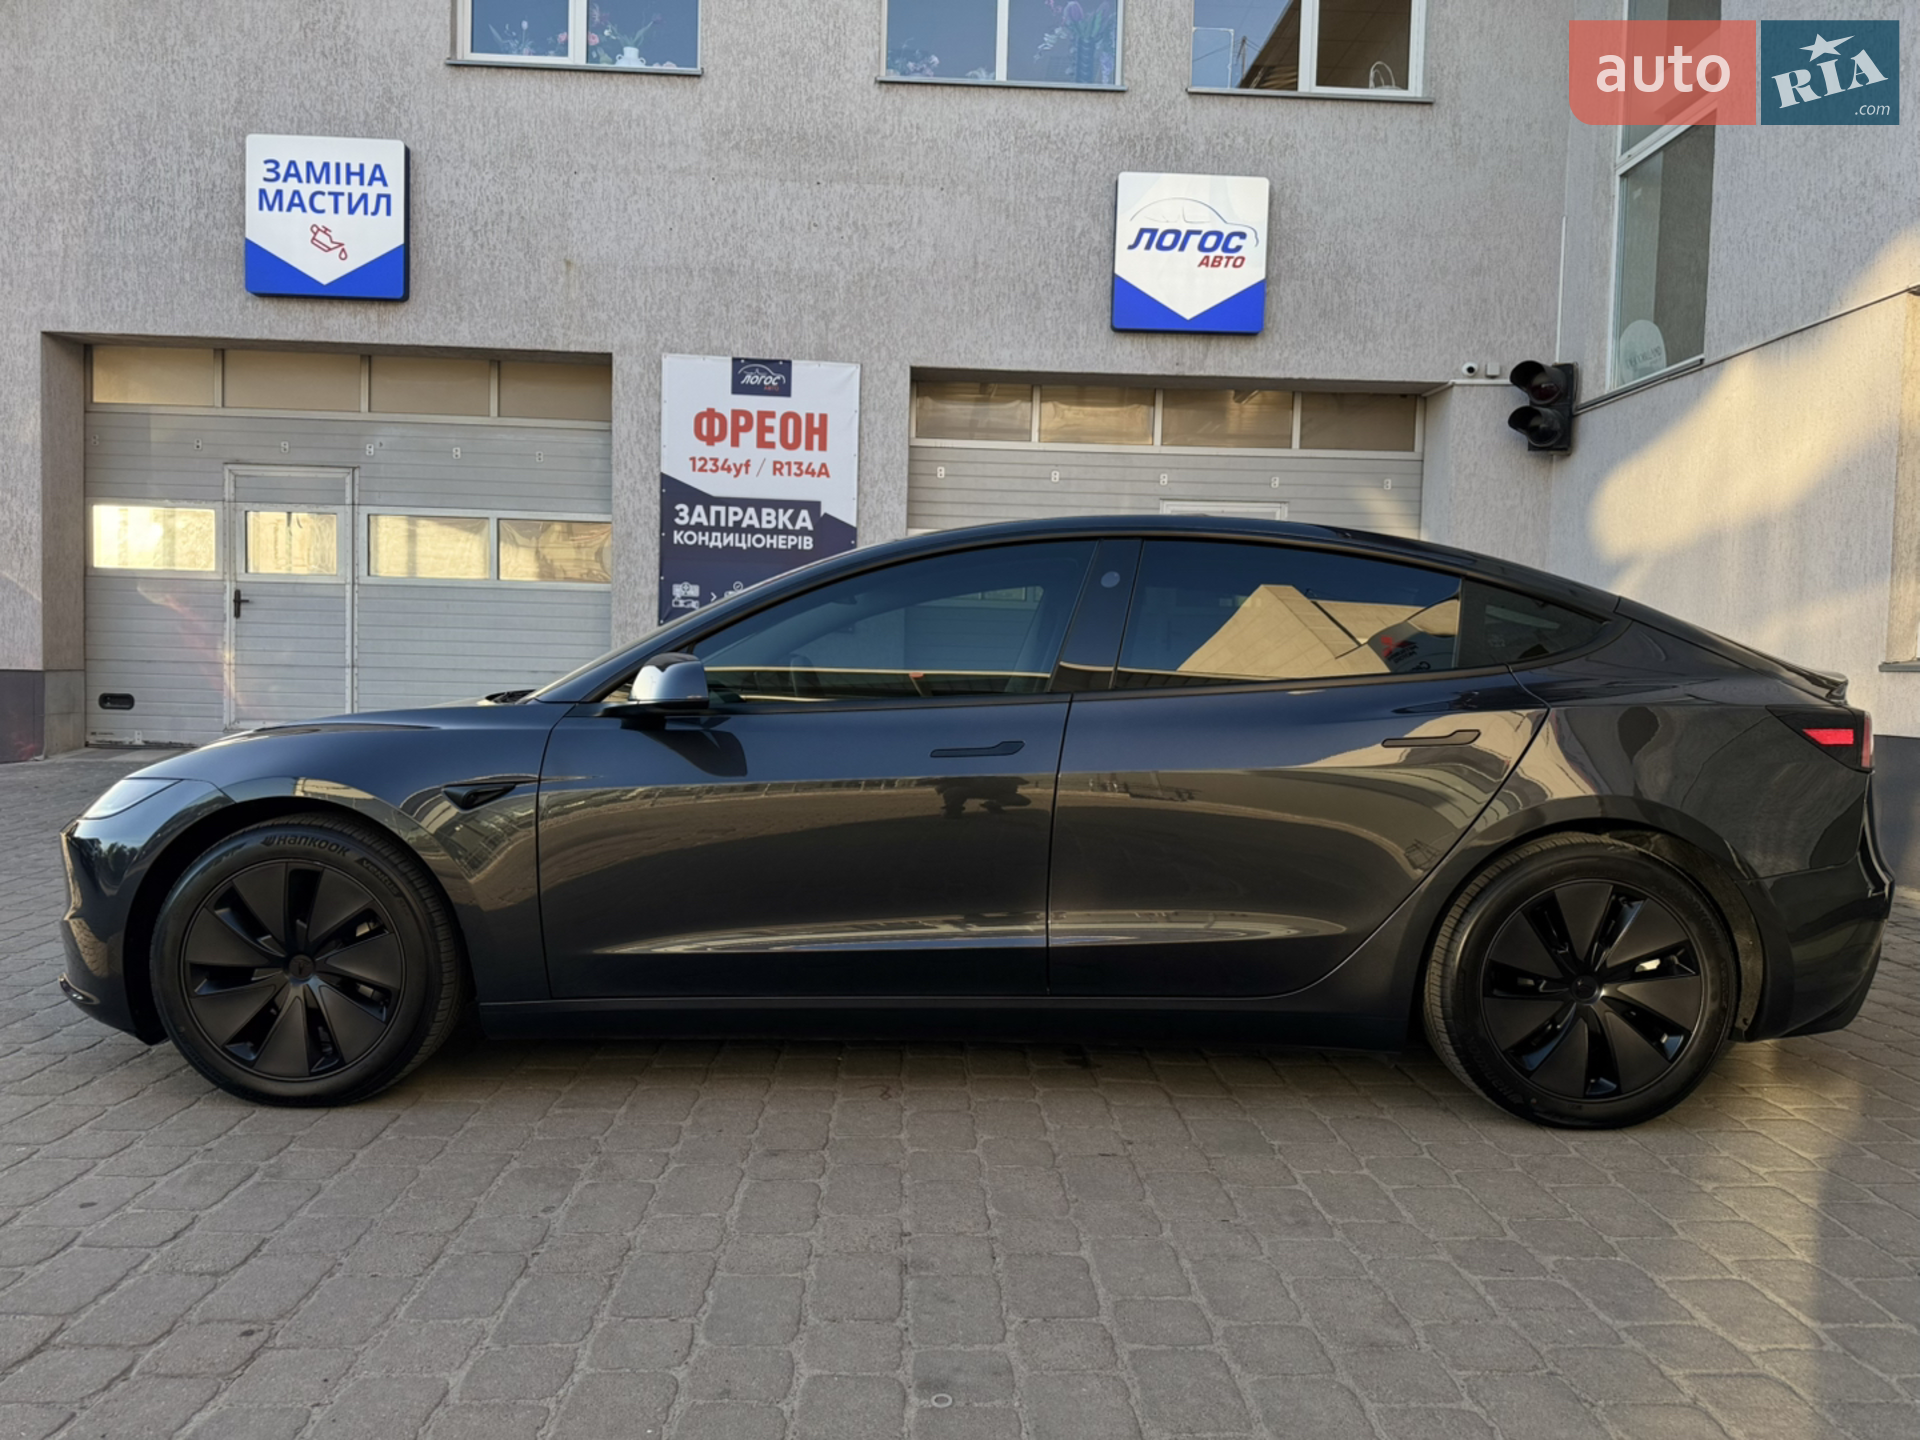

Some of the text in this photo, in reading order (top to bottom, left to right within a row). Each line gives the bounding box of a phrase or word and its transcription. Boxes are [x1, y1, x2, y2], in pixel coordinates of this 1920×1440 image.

[262, 158, 388, 187] ЗАМІНА
[258, 188, 392, 216] МАСТИЛ
[1127, 227, 1247, 254] ЛОГОС
[1197, 255, 1246, 268] АВТО
[740, 374, 781, 386] ЛОГОС
[693, 407, 828, 452] ФРЕОН
[689, 456, 751, 478] 1234yf
[772, 460, 830, 478] R134A
[674, 503, 814, 531] ЗАПРАВКА
[673, 530, 814, 550] КОНДИЦІОНЕРІВ
